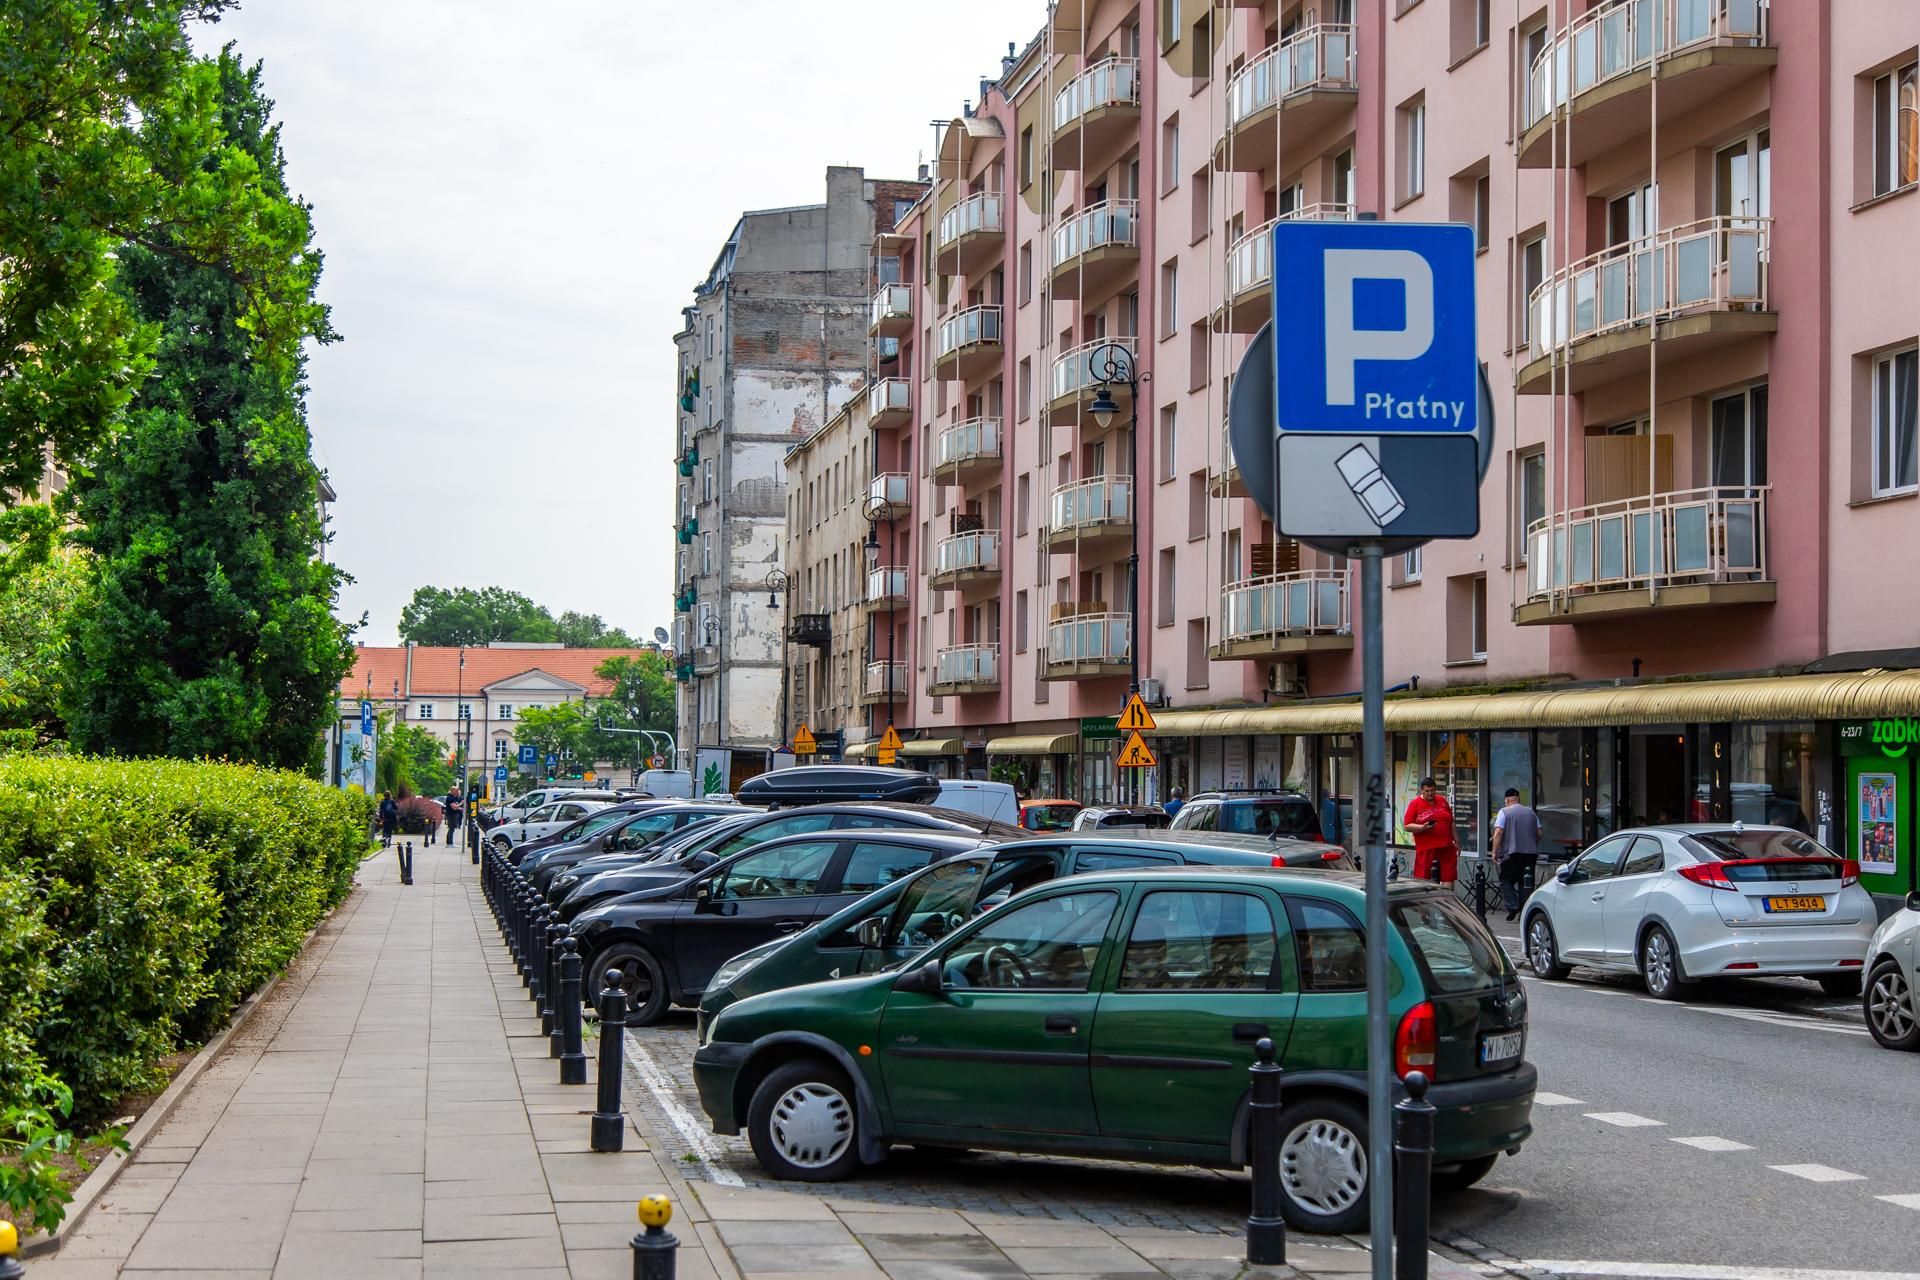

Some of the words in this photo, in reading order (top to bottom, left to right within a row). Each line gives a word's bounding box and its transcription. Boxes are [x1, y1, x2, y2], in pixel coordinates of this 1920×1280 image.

[1323, 248, 1435, 406] P
[1365, 391, 1466, 427] Płatny
[364, 704, 371, 725] P
[1841, 726, 1863, 737] 6-23/7
[522, 747, 534, 762] P
[498, 769, 506, 779] P
[1775, 898, 1789, 909] LT
[1791, 898, 1818, 908] 9414
